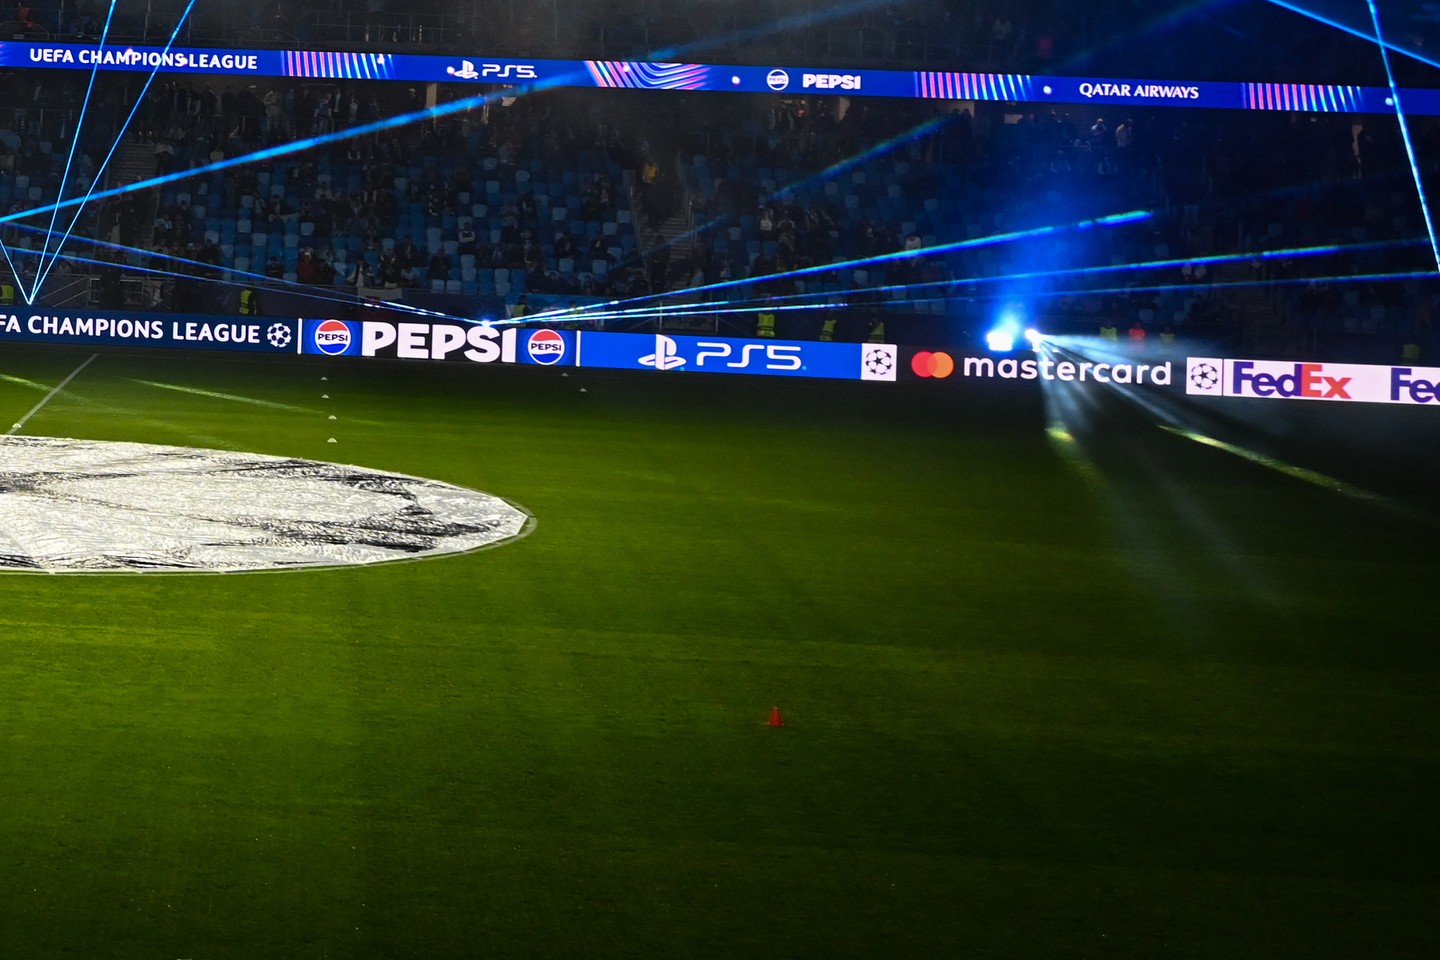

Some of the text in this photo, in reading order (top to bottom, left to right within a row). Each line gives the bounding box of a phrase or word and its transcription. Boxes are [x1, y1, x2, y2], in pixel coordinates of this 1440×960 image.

[30, 48, 258, 70] UEFA CHAMPIONS LEAGUE
[482, 64, 535, 78] PS5
[802, 73, 861, 90] PEPSI
[1079, 83, 1199, 99] QATAR AIRWAYS
[28, 315, 164, 339] CHAMPIONS
[172, 321, 260, 344] LEAGUE
[318, 333, 348, 342] PEPSI
[361, 321, 517, 363] PEPSI
[530, 343, 562, 351] PEPSI
[696, 342, 802, 371] PS5
[963, 356, 1172, 386] mastercard
[1233, 361, 1352, 400] FedEx
